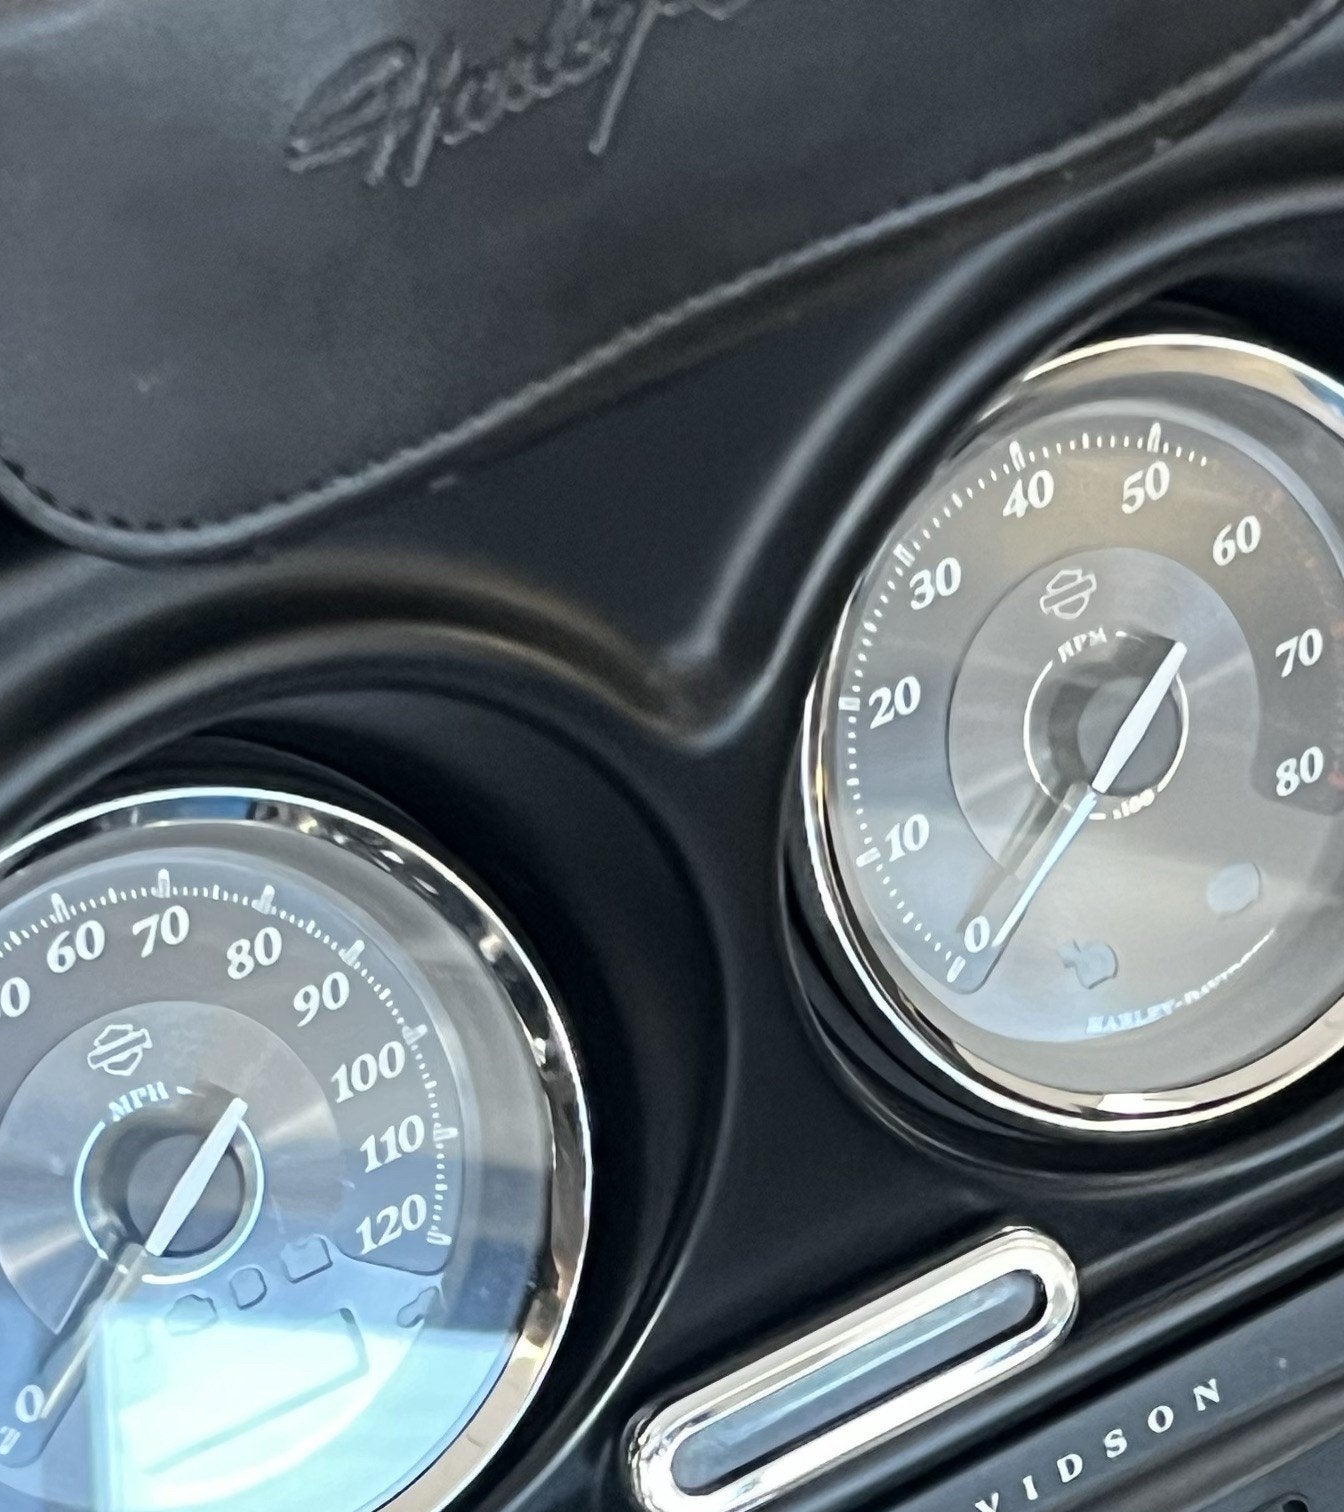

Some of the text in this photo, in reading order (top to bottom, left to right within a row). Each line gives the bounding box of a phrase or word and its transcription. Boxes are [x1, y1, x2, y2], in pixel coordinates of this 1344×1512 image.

[1001, 470, 1054, 519] 40
[1120, 461, 1171, 515] 50
[1211, 515, 1261, 567] 60
[909, 556, 962, 612] 30
[1058, 624, 1108, 665] RPM
[1275, 627, 1323, 679] 70
[868, 677, 922, 729] 20
[1275, 747, 1324, 797] 80
[883, 813, 931, 863] 10
[45, 919, 106, 973] 60
[131, 904, 190, 957] 70
[226, 925, 283, 980] 80
[963, 915, 990, 954] 0
[291, 971, 350, 1028] 90
[329, 1040, 406, 1103] 100
[108, 1080, 169, 1123] MPH
[359, 1113, 426, 1172] 110
[354, 1193, 426, 1254] 120
[14, 1383, 41, 1424] 0
